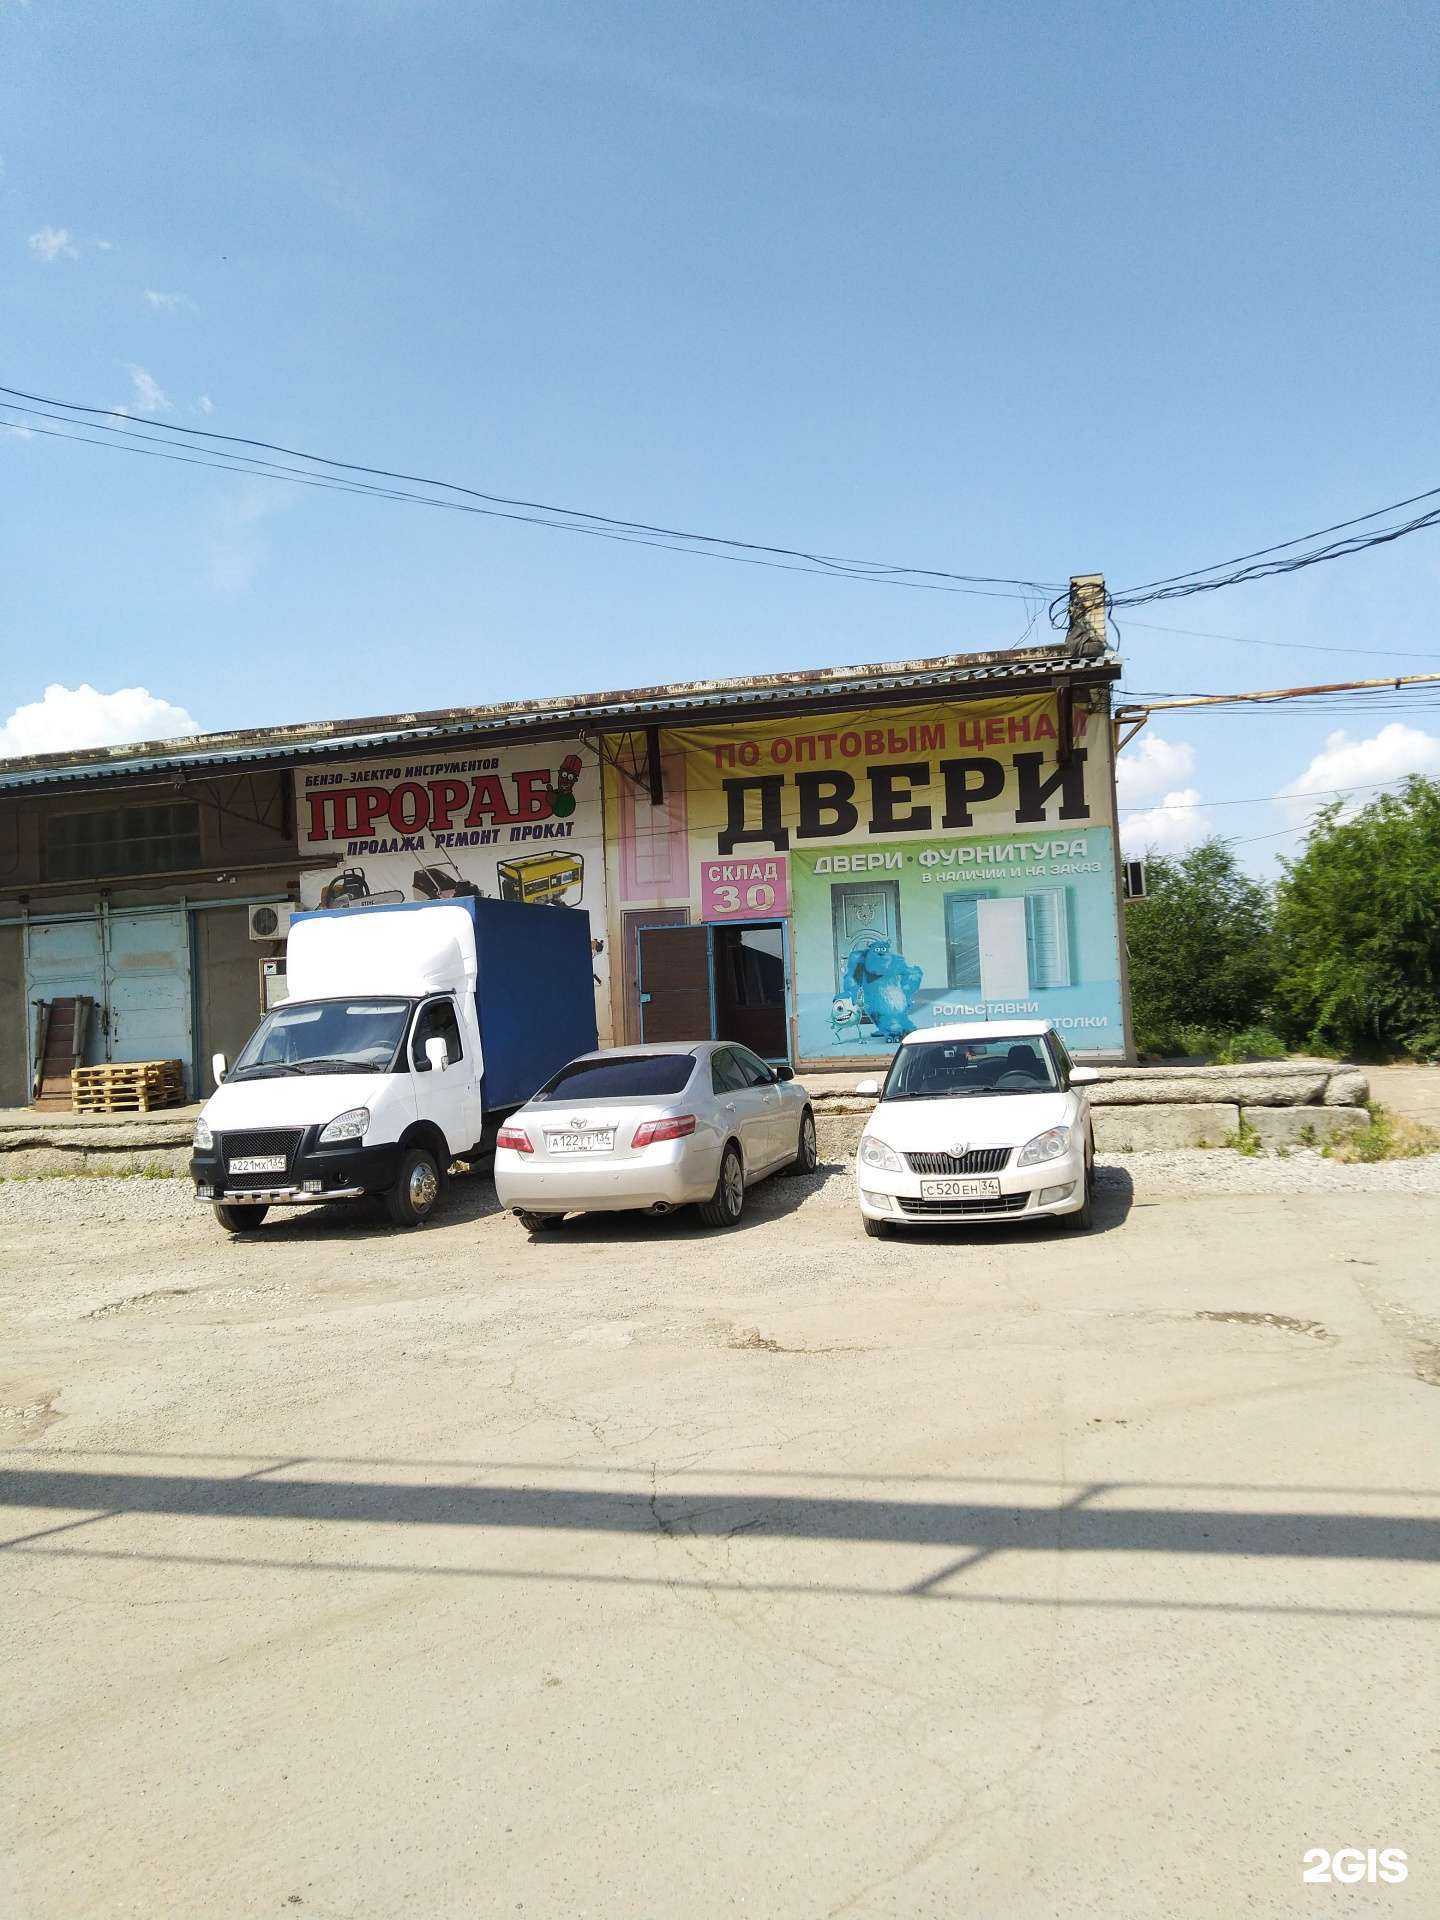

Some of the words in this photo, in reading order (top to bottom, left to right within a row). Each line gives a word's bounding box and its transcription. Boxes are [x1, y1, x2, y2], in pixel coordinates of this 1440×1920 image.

[714, 741, 760, 769] ПО
[770, 724, 946, 764] ОПТОВЫМ
[305, 767, 401, 787] БЕНЗО-ЭЛЕКТРО
[404, 757, 499, 778] ИНСТРУМЕНТОВ
[305, 769, 554, 841] ПРОРАБ
[718, 748, 1090, 855] ДВЕРИ
[347, 835, 425, 856] ПРОДАЖА
[435, 828, 500, 848] РЕМОНТ
[510, 821, 574, 842] ПРОКАТ
[814, 852, 903, 875] ДВЕРИ
[918, 839, 1089, 868] ФУРНИТУРА
[708, 863, 778, 882] СКЛАД
[922, 873, 932, 884] В
[936, 868, 1005, 883] НАЛИЧИИ
[1010, 866, 1021, 878] И
[1025, 864, 1046, 877] НА
[1050, 861, 1102, 875] ЗАКАЗ
[712, 883, 775, 913] 30
[933, 1002, 1040, 1016] РОЛЬСТАВНИ
[981, 1181, 995, 1190] 34
